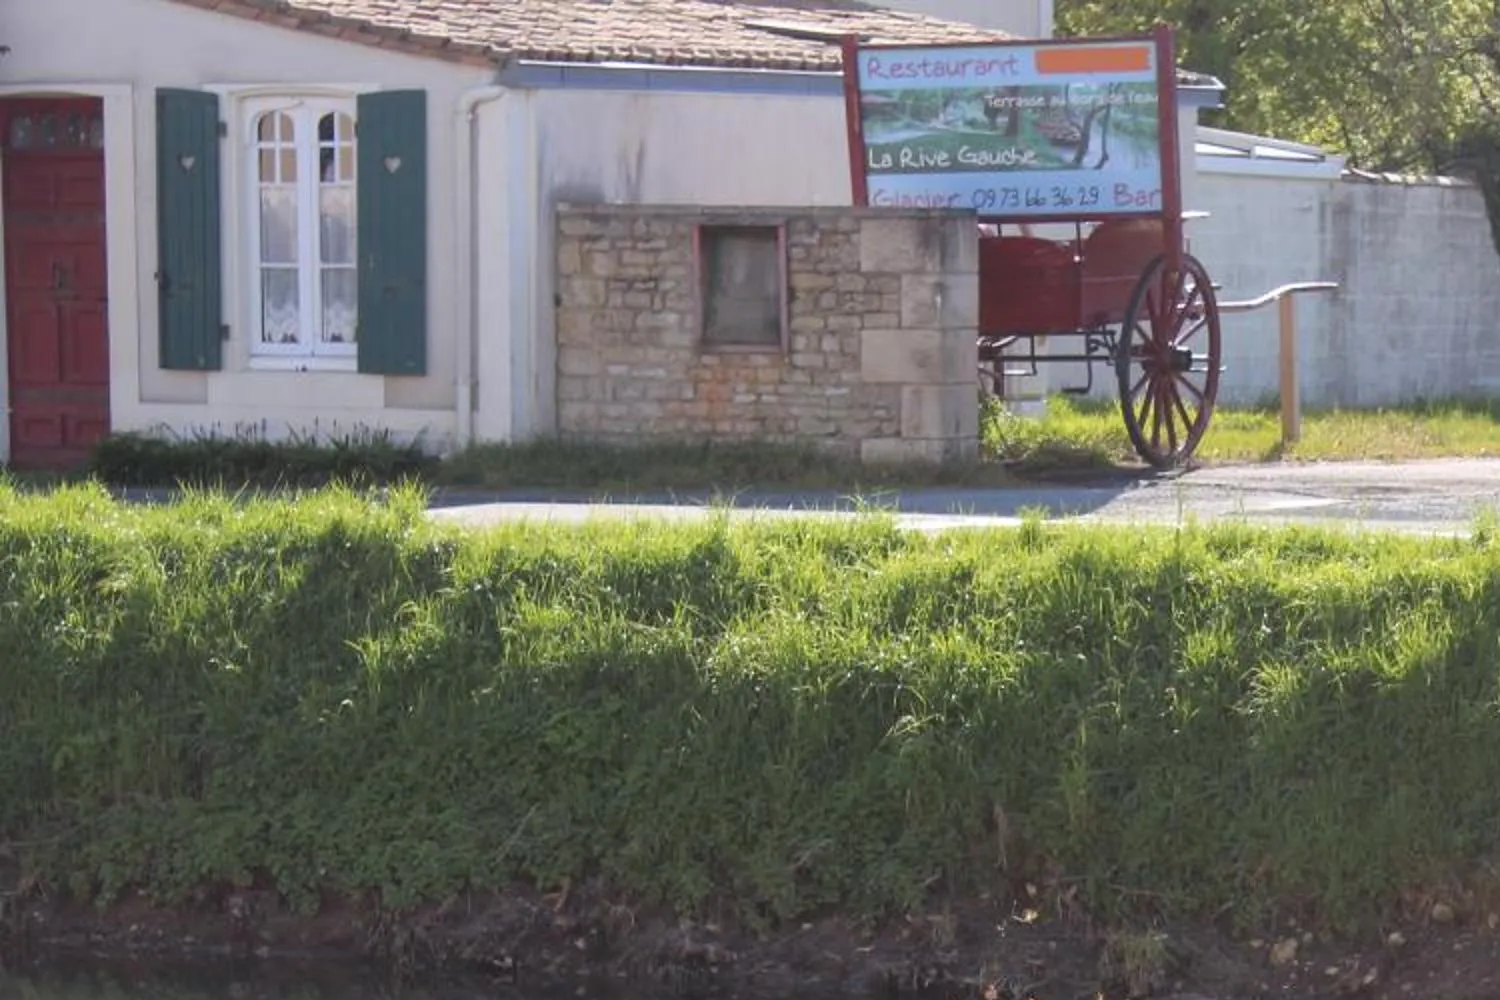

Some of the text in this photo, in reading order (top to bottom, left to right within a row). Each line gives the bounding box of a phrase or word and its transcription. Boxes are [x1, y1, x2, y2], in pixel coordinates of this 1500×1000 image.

[867, 57, 1021, 79] Restaurant
[868, 145, 1040, 168] La Rive Gauche
[1113, 183, 1163, 207] Bar
